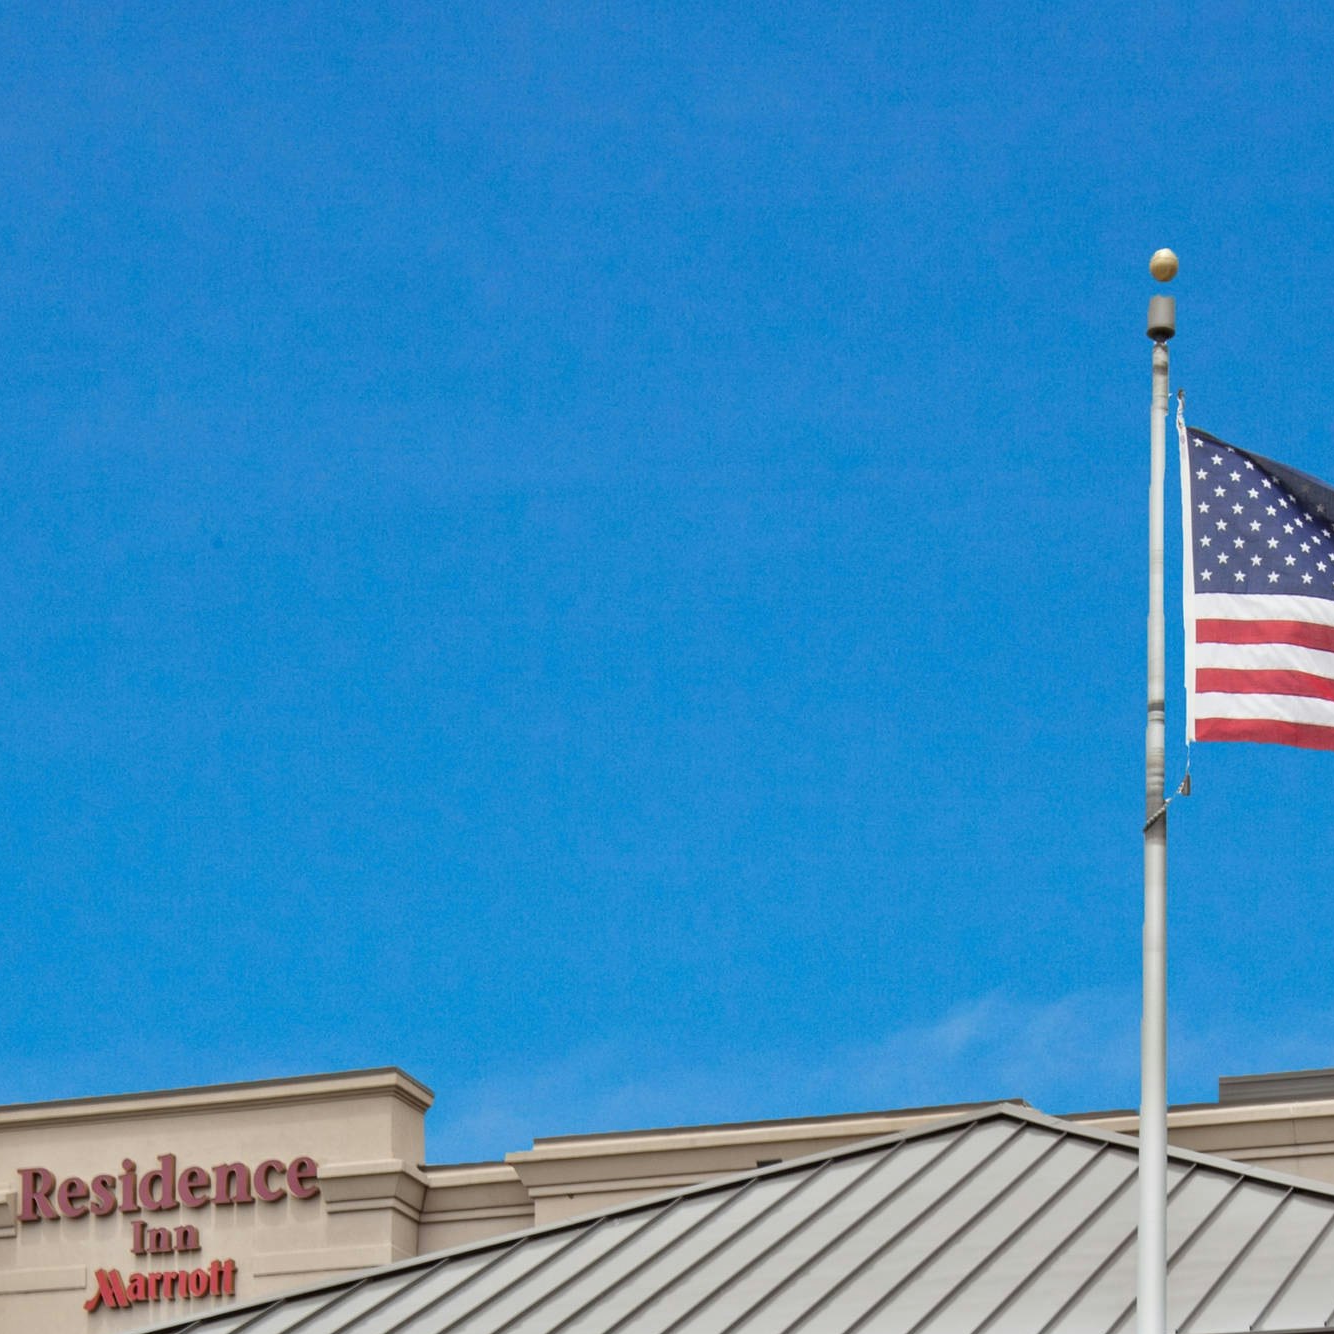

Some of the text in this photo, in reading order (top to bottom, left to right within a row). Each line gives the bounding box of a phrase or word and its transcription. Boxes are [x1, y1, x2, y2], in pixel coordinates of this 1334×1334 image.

[17, 1153, 320, 1222] Residence
[130, 1220, 201, 1255] Inn
[83, 1258, 237, 1313] Marriott
